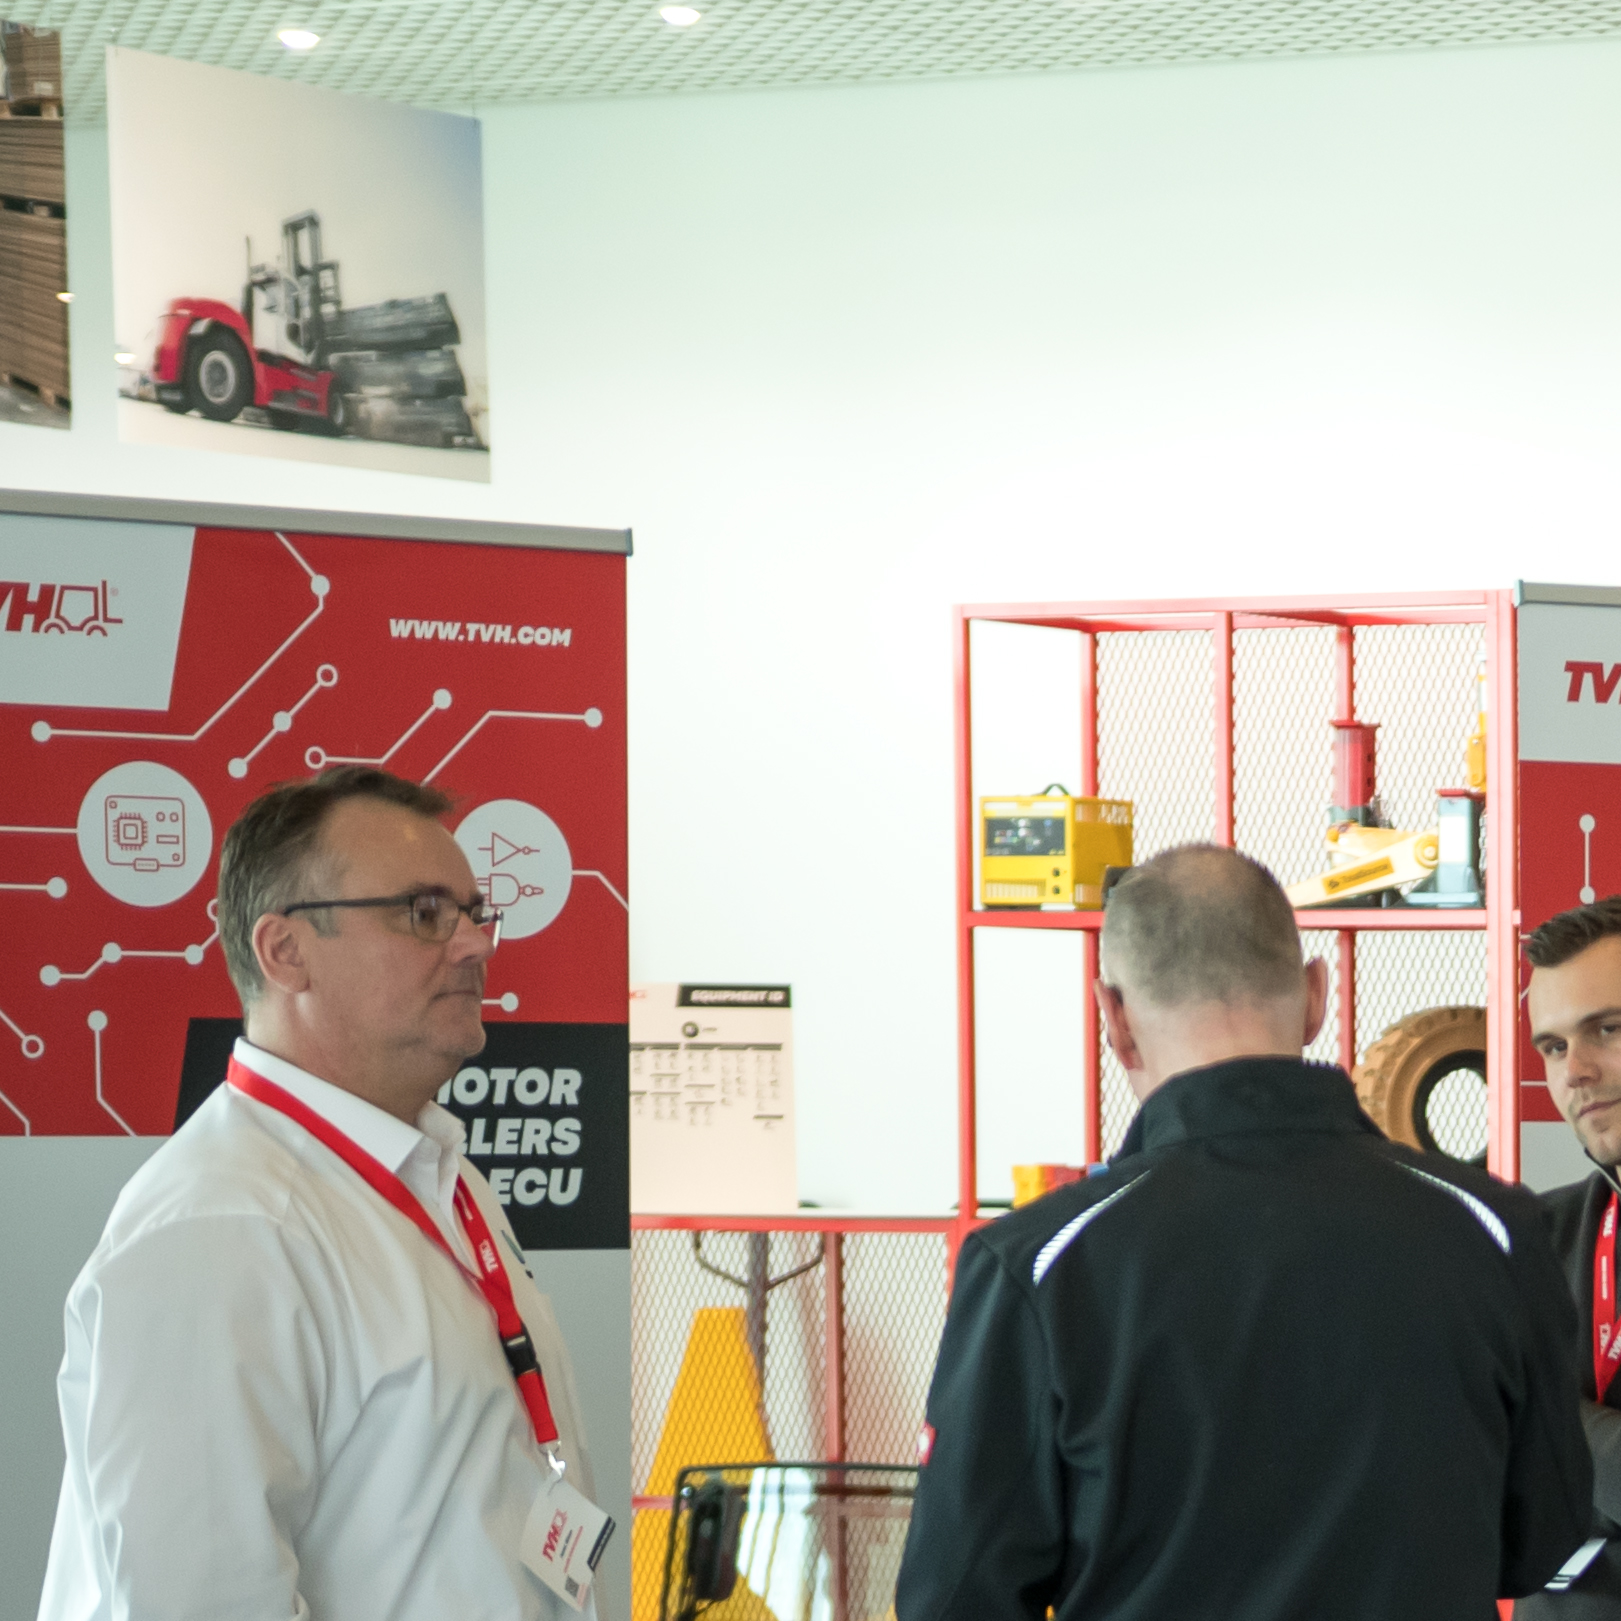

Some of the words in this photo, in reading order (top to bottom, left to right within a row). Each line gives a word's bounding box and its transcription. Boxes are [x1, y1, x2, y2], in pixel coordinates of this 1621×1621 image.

[389, 618, 572, 648] WWW.TVH.COM
[463, 1117, 582, 1156] LERS
[489, 1167, 583, 1206] ECU
